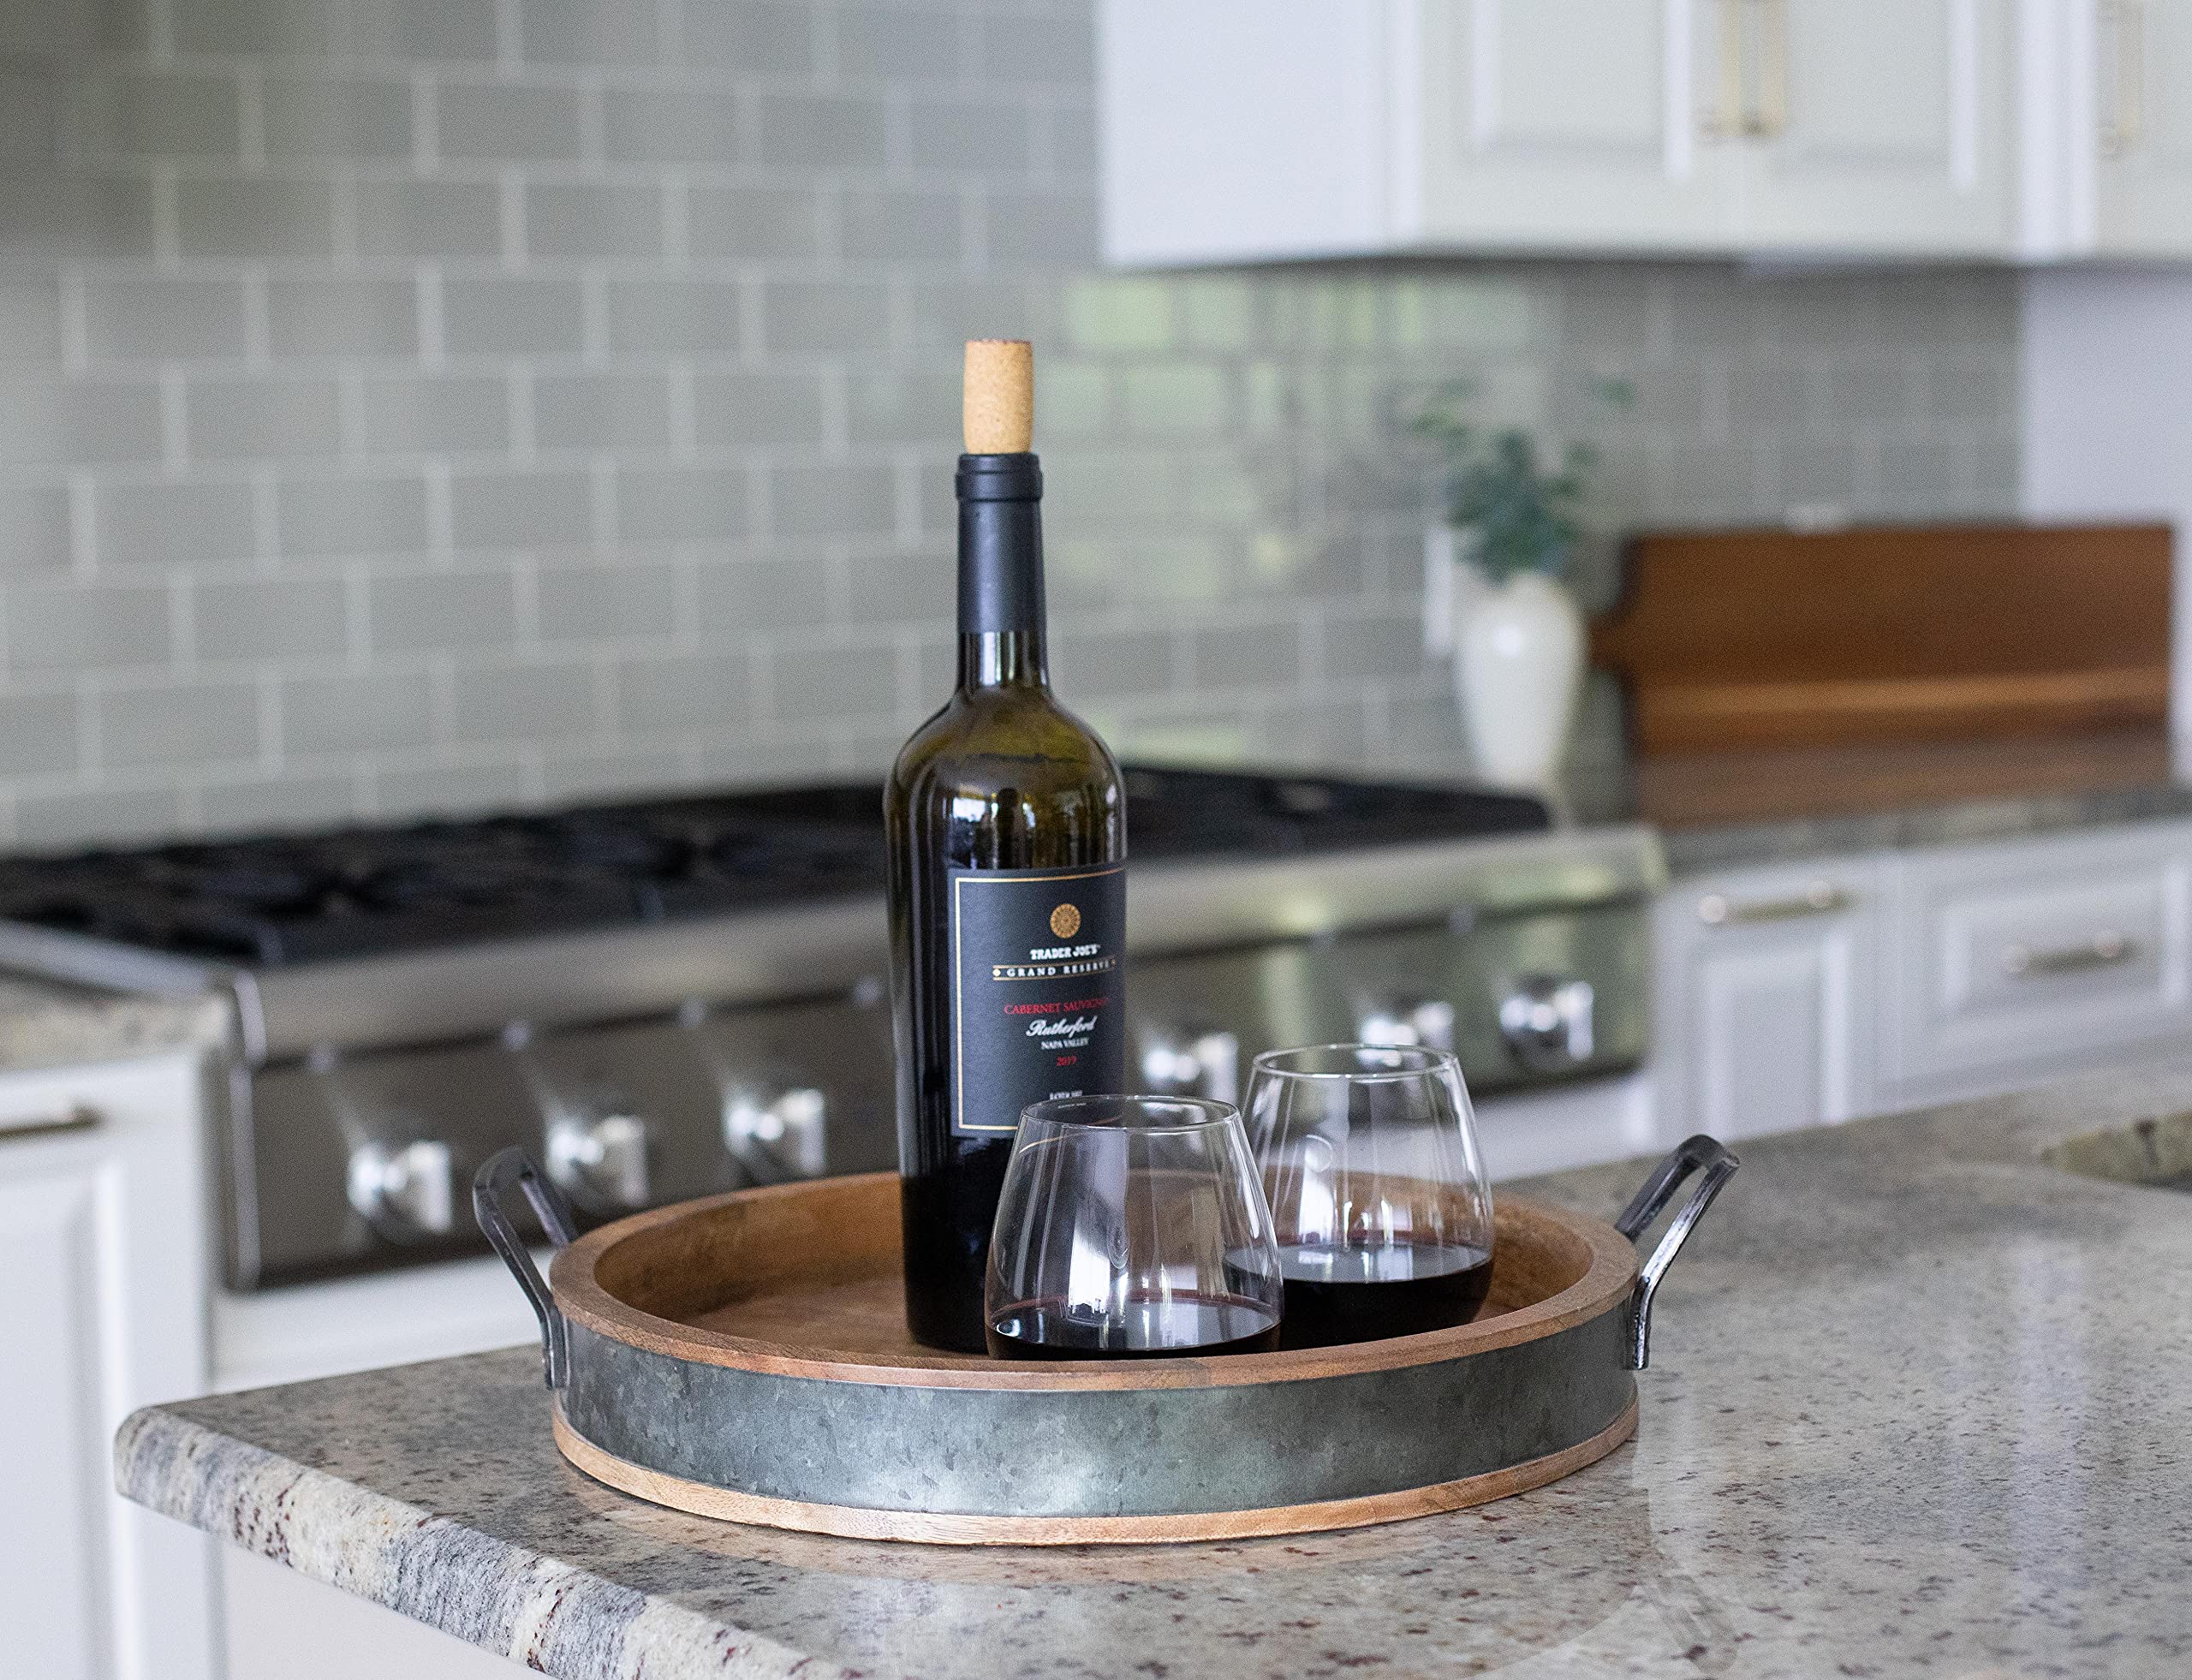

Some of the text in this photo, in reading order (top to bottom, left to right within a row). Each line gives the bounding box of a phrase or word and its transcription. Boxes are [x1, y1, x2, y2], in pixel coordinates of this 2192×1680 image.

[1030, 946, 1071, 960] TRADER
[1006, 960, 1110, 978] GRAND RESERVE
[1004, 1002, 1063, 1015] CABERNET
[1026, 1016, 1099, 1038] Rutherford
[1040, 1037, 1090, 1051] NAPA VALLEY
